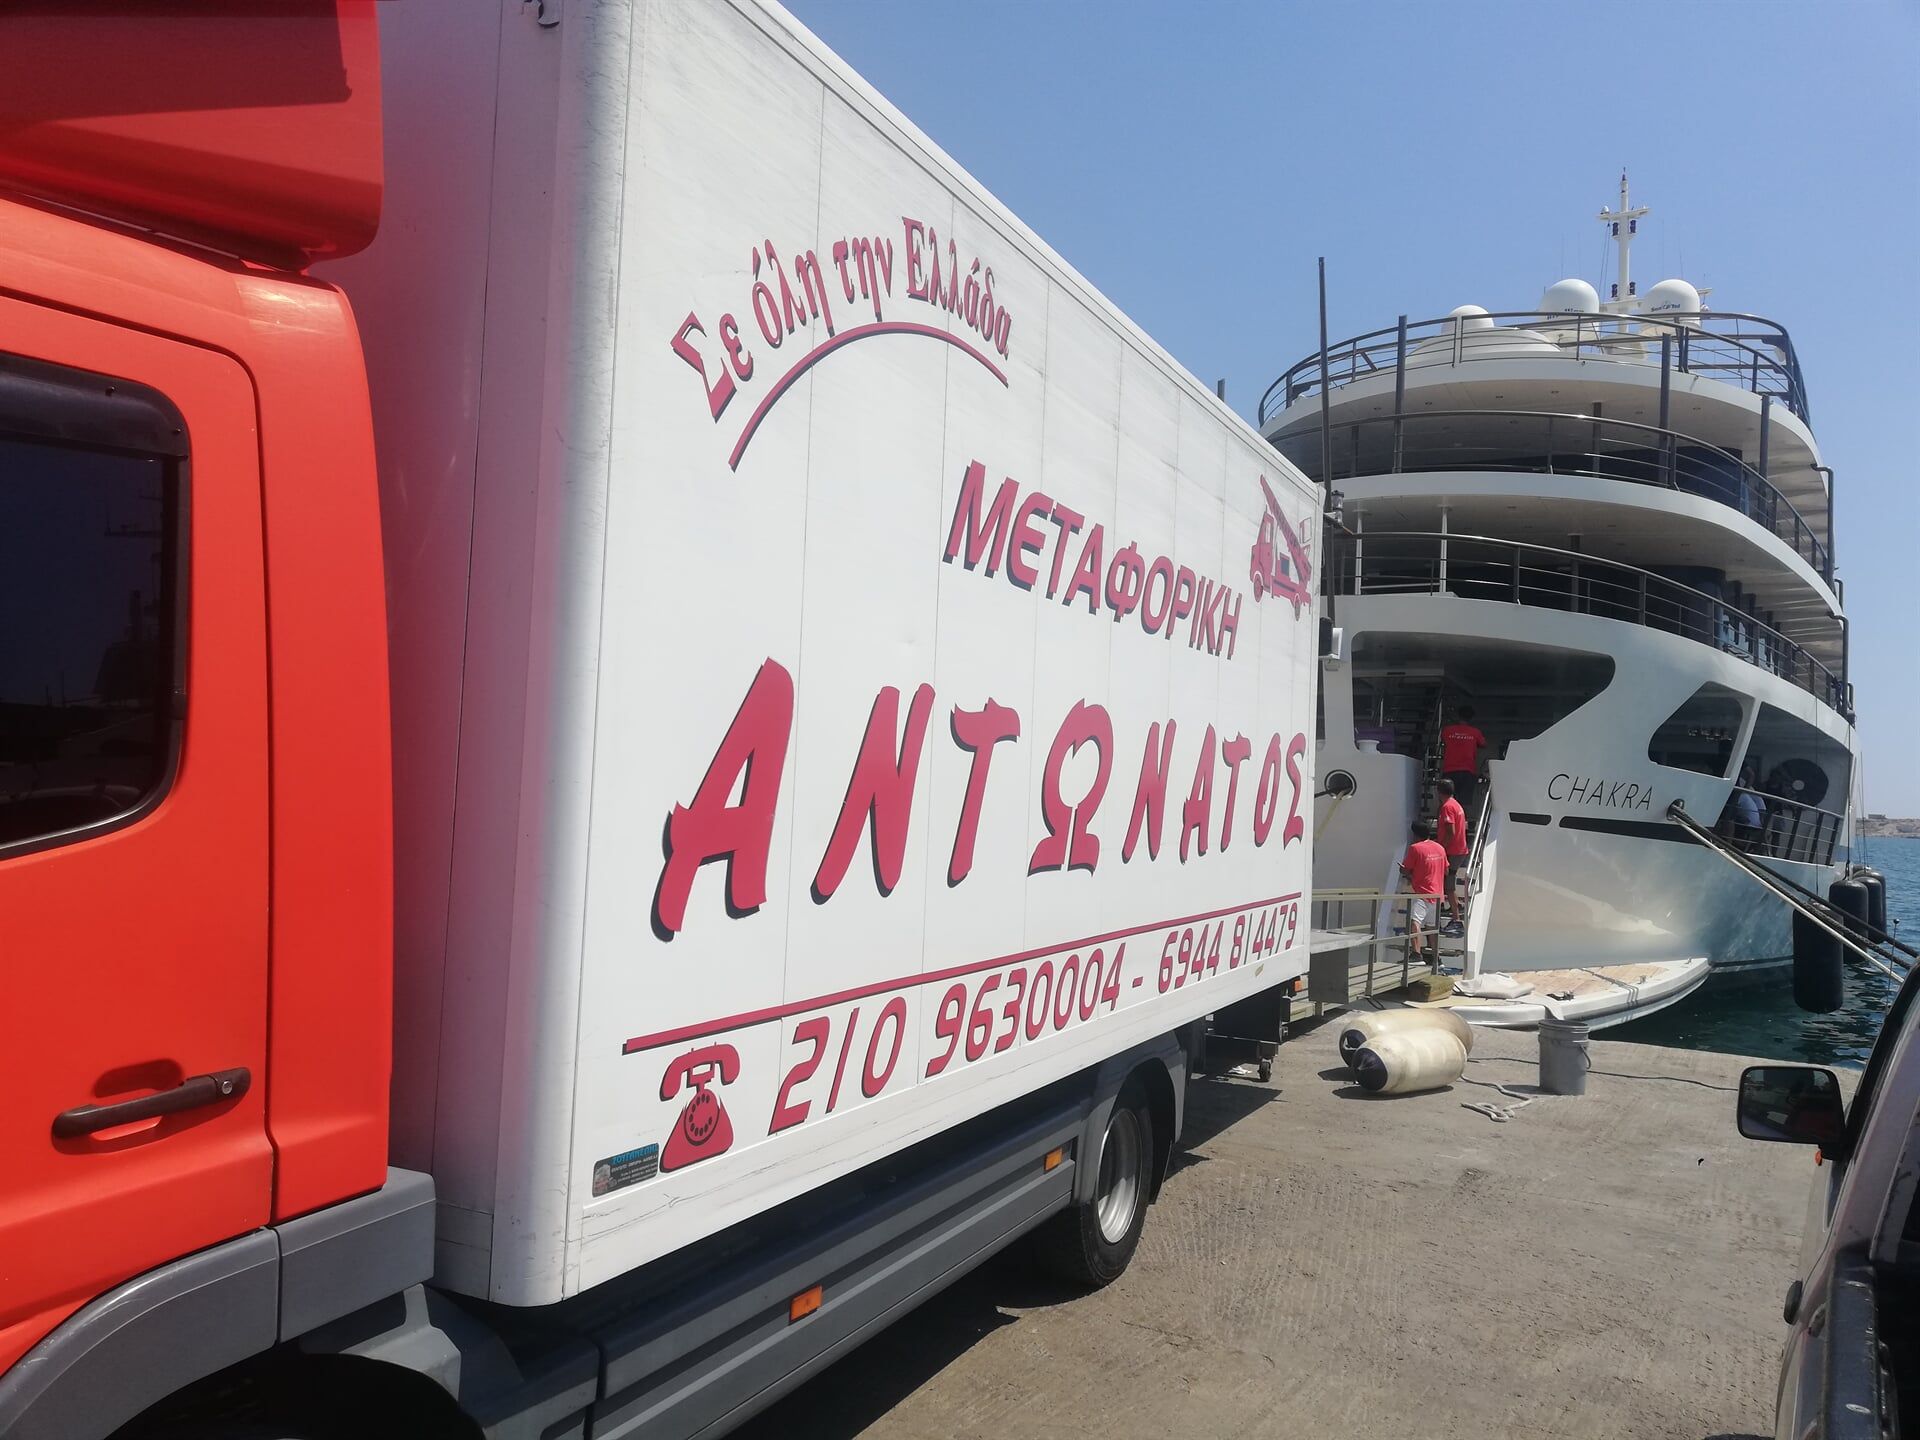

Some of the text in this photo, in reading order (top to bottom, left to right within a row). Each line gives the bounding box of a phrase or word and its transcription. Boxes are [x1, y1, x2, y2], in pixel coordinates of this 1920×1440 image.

[670, 216, 1012, 423] Σε όλη την Ελλάδα
[942, 459, 1242, 660] ΜΕΤΑΦΟΡΙΚΗ
[651, 656, 1306, 943] ΑΝΤΩΝΑΤΟΣ
[1548, 773, 1652, 810] CHAKRA
[768, 996, 906, 1136] 210
[925, 942, 1126, 1078] 9630004
[1158, 919, 1225, 994] 6944
